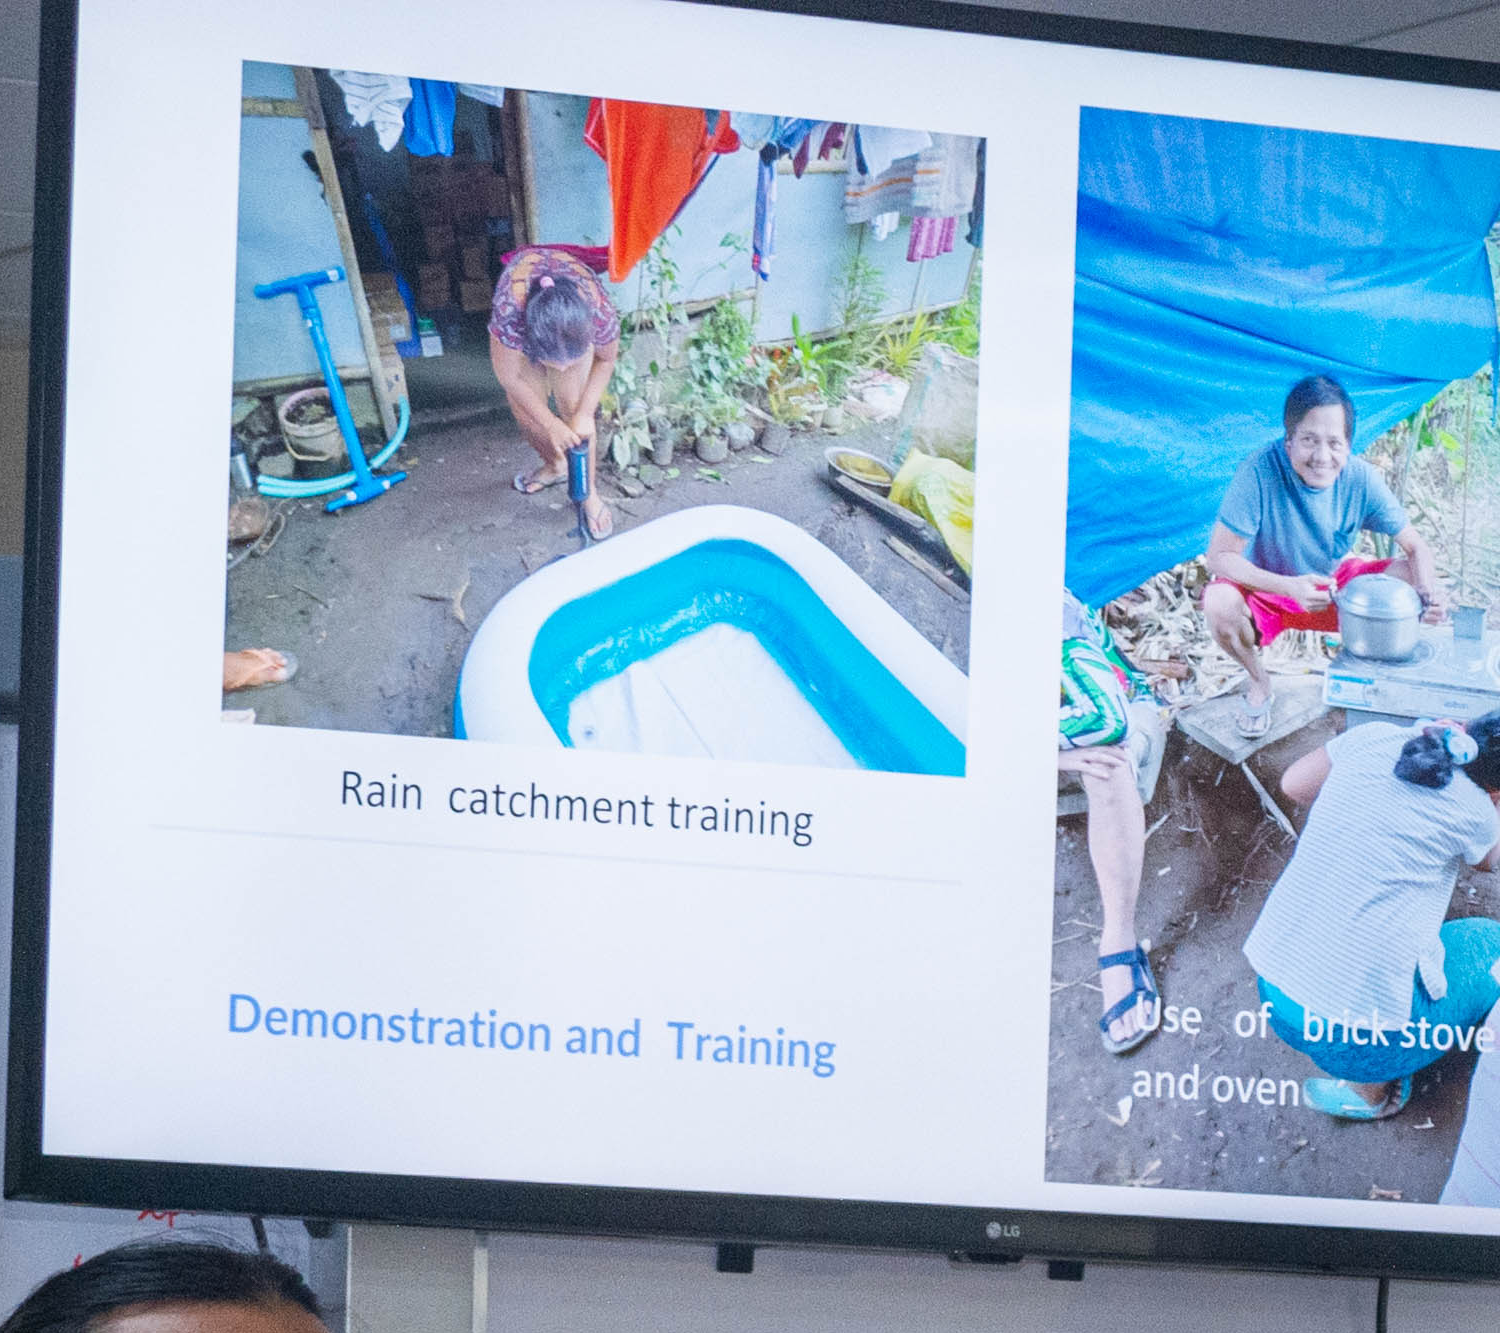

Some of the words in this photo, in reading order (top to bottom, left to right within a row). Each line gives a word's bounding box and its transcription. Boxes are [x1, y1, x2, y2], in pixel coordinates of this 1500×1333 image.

[341, 769, 423, 811] Rain
[448, 781, 655, 828] catchment
[667, 796, 814, 848] training
[228, 993, 551, 1053] Demonstration
[564, 1018, 641, 1058] and
[666, 1020, 837, 1079] Training
[1137, 996, 1202, 1036] Use
[1235, 1002, 1274, 1039] of
[1303, 1005, 1390, 1046] brick
[1400, 1017, 1498, 1053] stove
[1132, 1064, 1199, 1101] and
[1212, 1076, 1300, 1107] oven
[1003, 1225, 1021, 1238] LG
